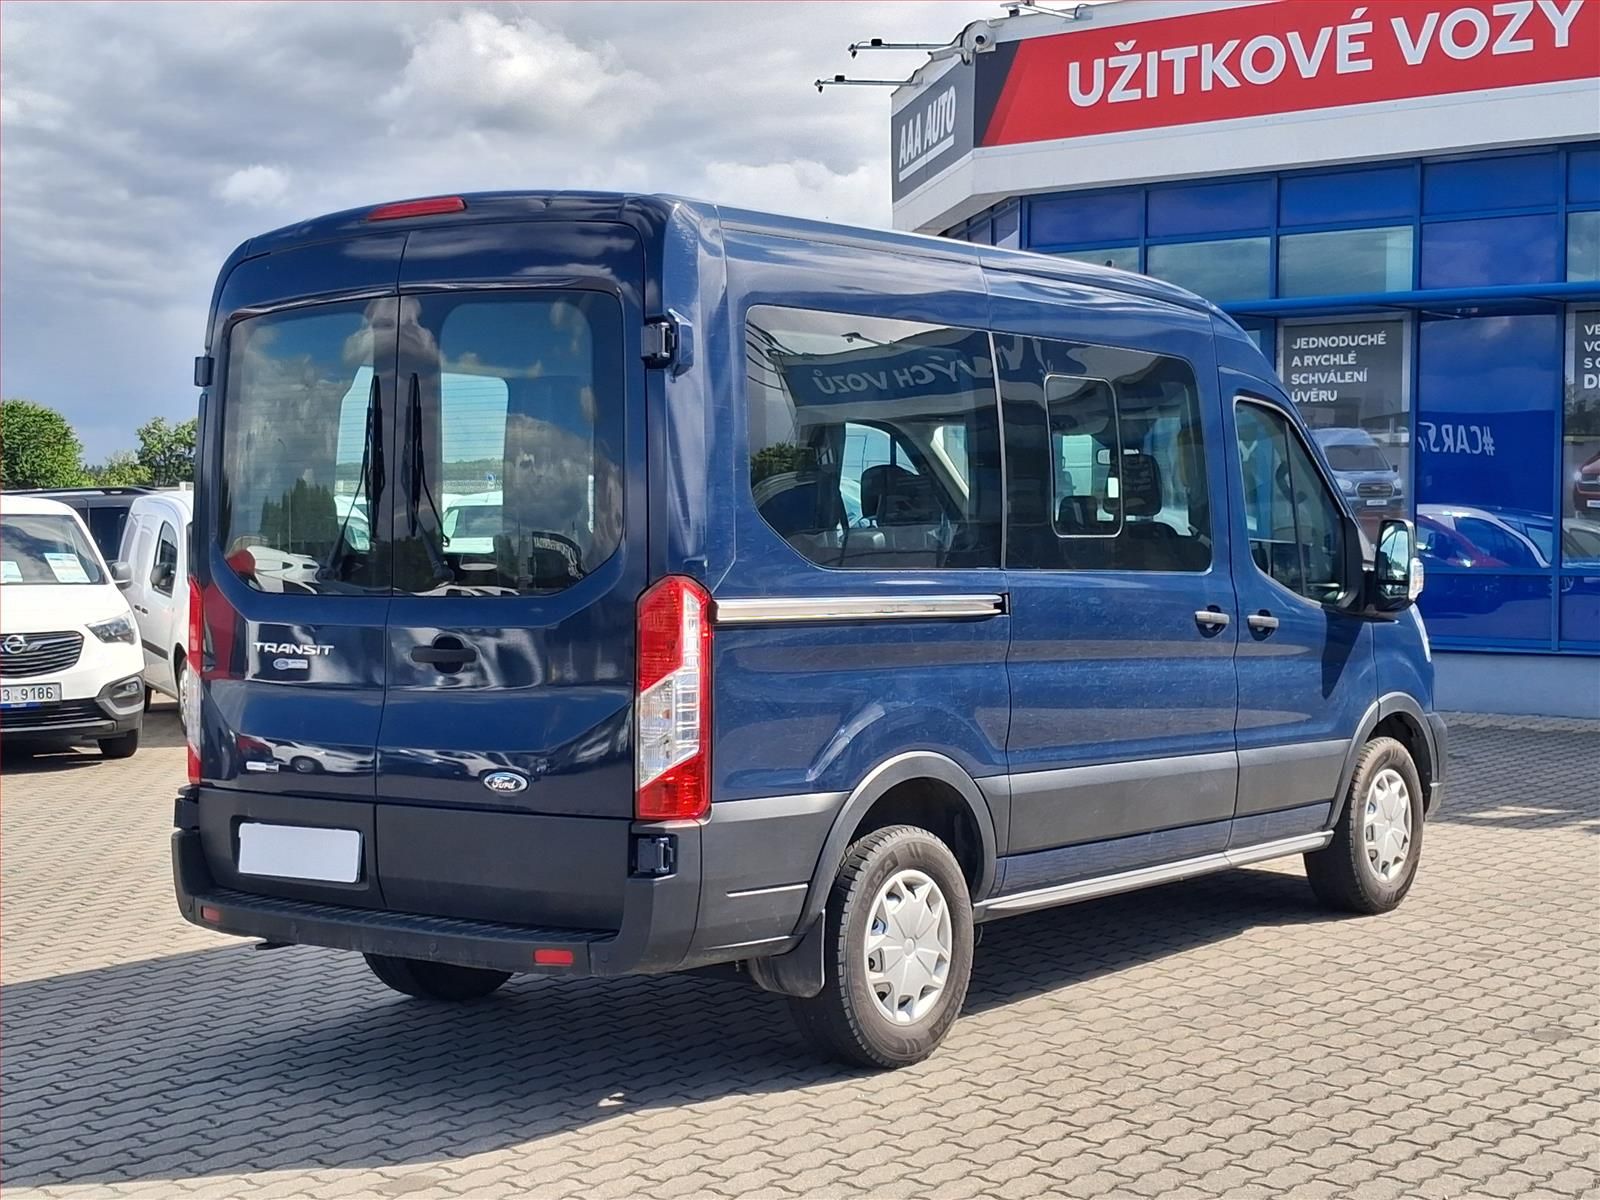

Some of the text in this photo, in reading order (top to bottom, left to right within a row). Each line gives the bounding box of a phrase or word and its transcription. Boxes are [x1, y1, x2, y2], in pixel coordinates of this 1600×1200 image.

[1068, 0, 1585, 107] UŽITKOVÉ VOZY
[899, 84, 956, 169] AAA AUTO
[1291, 330, 1387, 349] JEDNODUCHÉ
[1291, 350, 1357, 367] A RYCHLÉ
[1291, 367, 1368, 385] SCHVÁLENÍ
[1583, 373, 1600, 389] D
[1291, 388, 1338, 403] ÚVĚRU
[253, 642, 335, 656] TRANSIT
[491, 776, 517, 789] Ford
